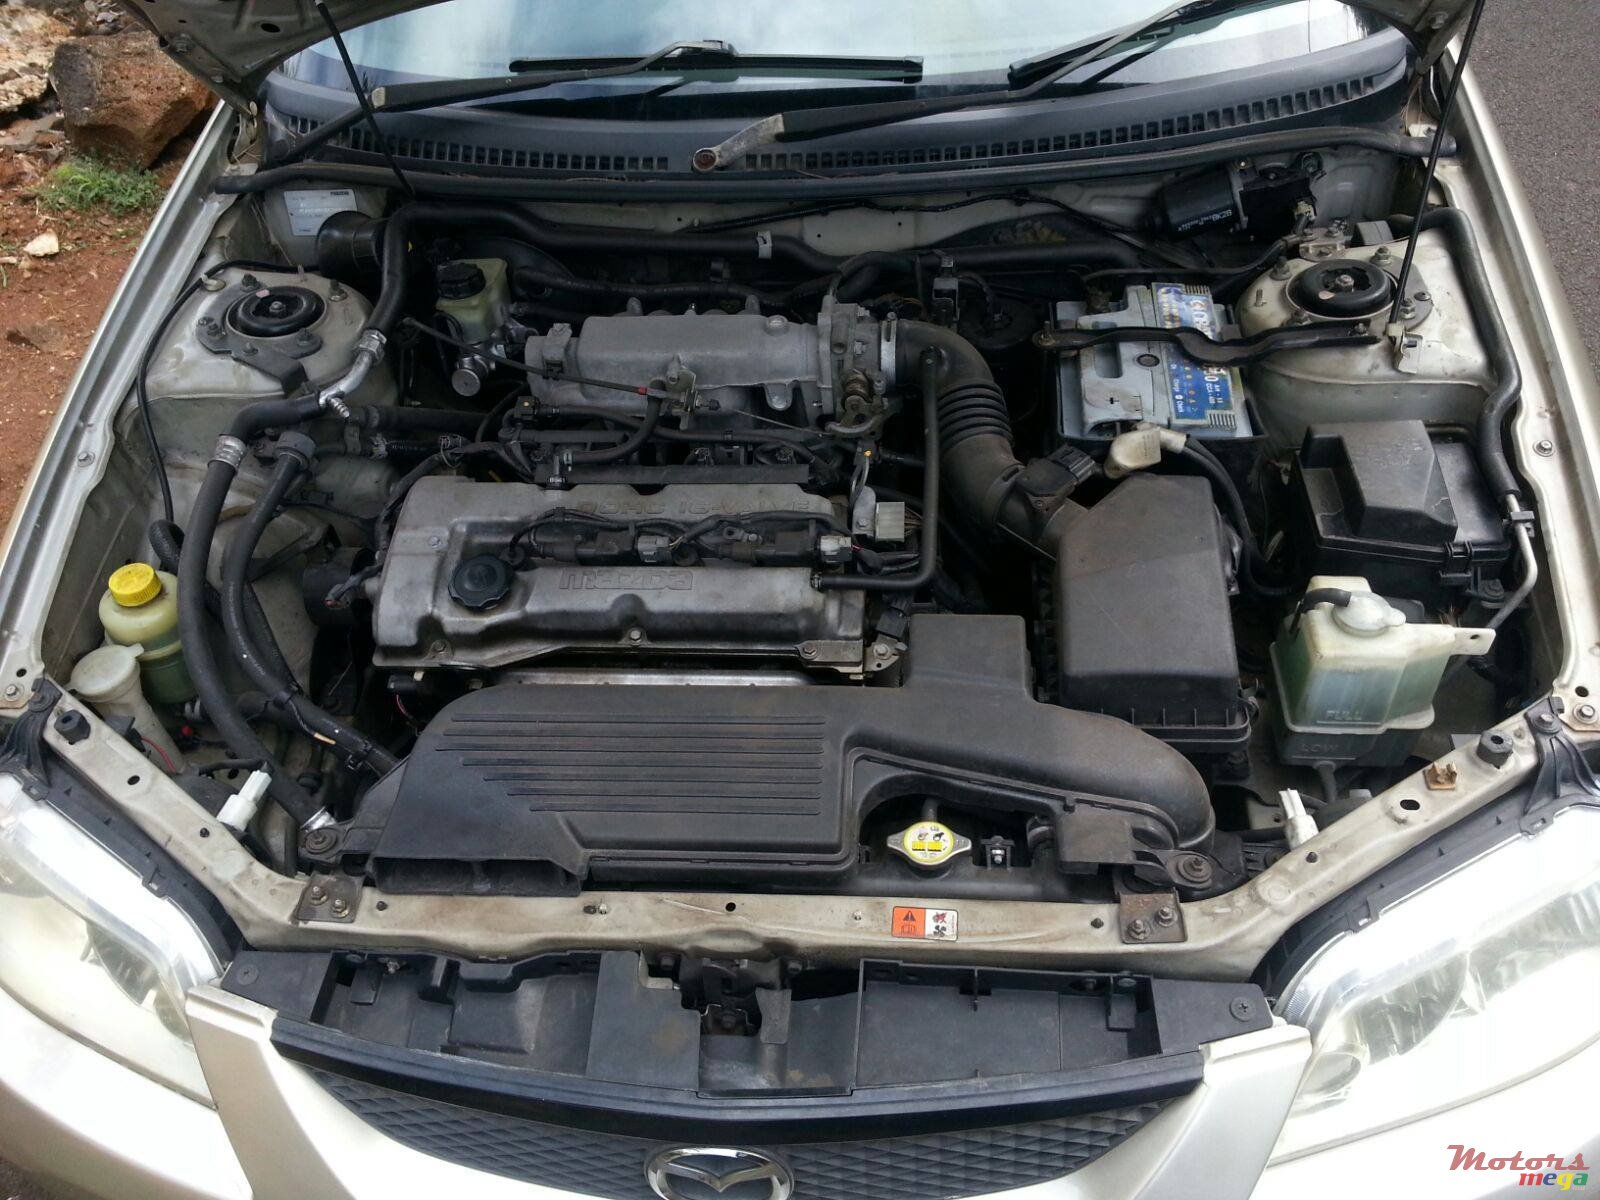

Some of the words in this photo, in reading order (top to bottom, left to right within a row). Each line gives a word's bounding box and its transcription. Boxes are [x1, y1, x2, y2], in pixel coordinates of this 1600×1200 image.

[576, 501, 665, 514] DOHC
[1326, 709, 1362, 721] FULL
[1301, 743, 1339, 752] LOW
